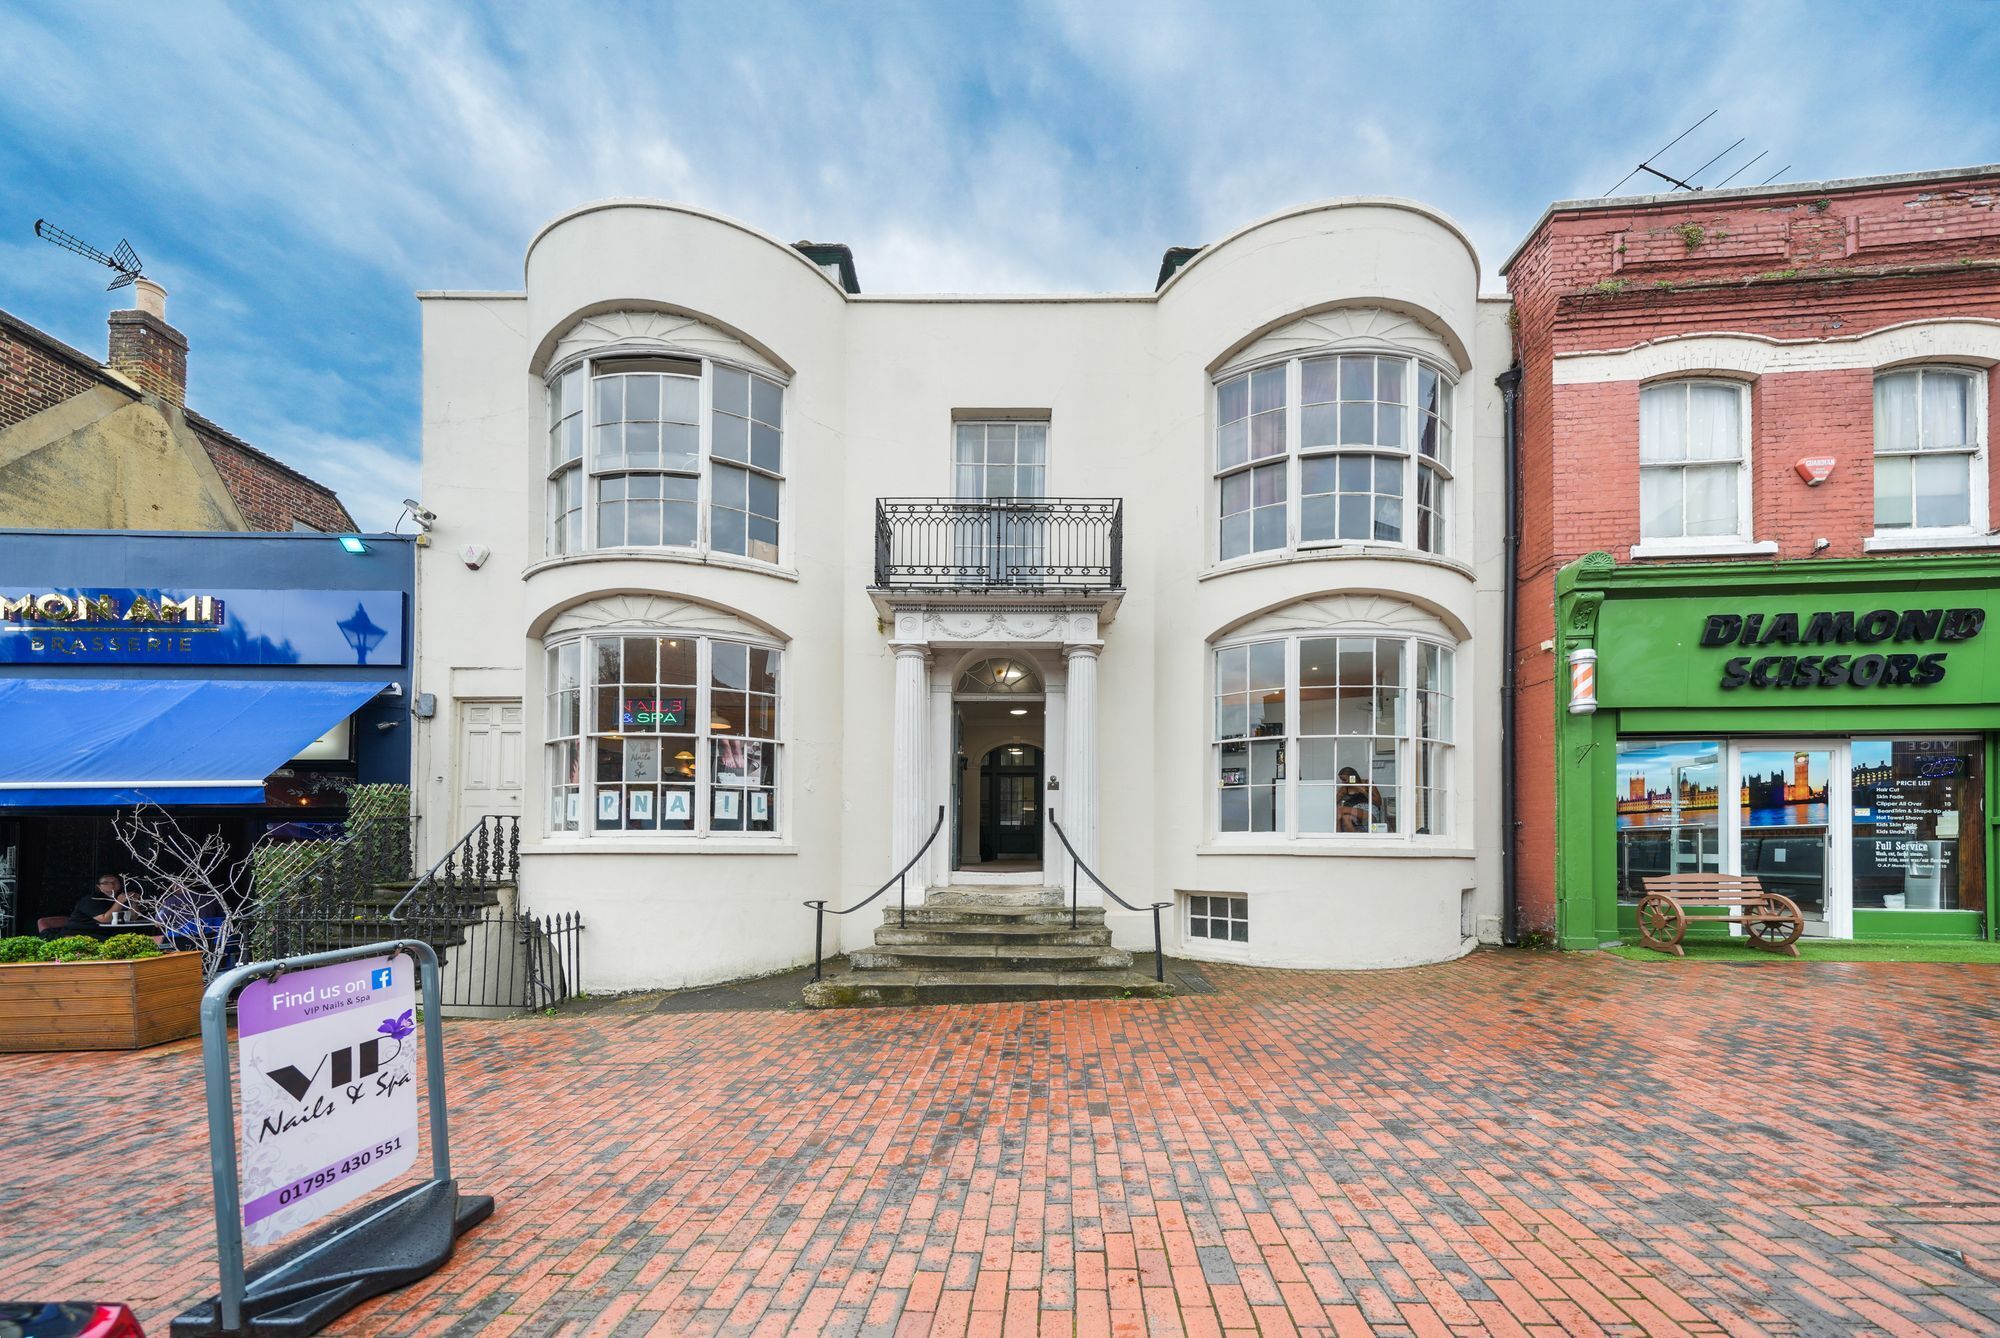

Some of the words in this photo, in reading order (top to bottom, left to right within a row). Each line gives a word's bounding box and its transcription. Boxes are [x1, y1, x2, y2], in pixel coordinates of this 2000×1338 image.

[0, 593, 114, 621] MON
[122, 594, 217, 621] AMI
[1700, 608, 1986, 646] DIAMOND
[31, 637, 193, 655] BRASSERIE
[1720, 653, 1948, 688] SCISSORS
[623, 713, 633, 723] &
[637, 712, 677, 723] SPA
[1921, 762, 1964, 774] OPEN
[1875, 841, 1891, 850] Full
[1896, 841, 1928, 851] Service
[273, 986, 315, 1011] Find
[320, 984, 341, 1000] us
[345, 979, 366, 994] on
[304, 1006, 320, 1016] VIP
[322, 1001, 345, 1012] Nails
[347, 998, 354, 1006] &
[355, 994, 371, 1004] Spa
[266, 1034, 402, 1102] VIP
[259, 1095, 336, 1144] Nails
[346, 1082, 366, 1104] &
[376, 1071, 412, 1098] Spa
[279, 1167, 336, 1206] 01795
[340, 1151, 371, 1176] 430
[375, 1136, 402, 1160] 551
